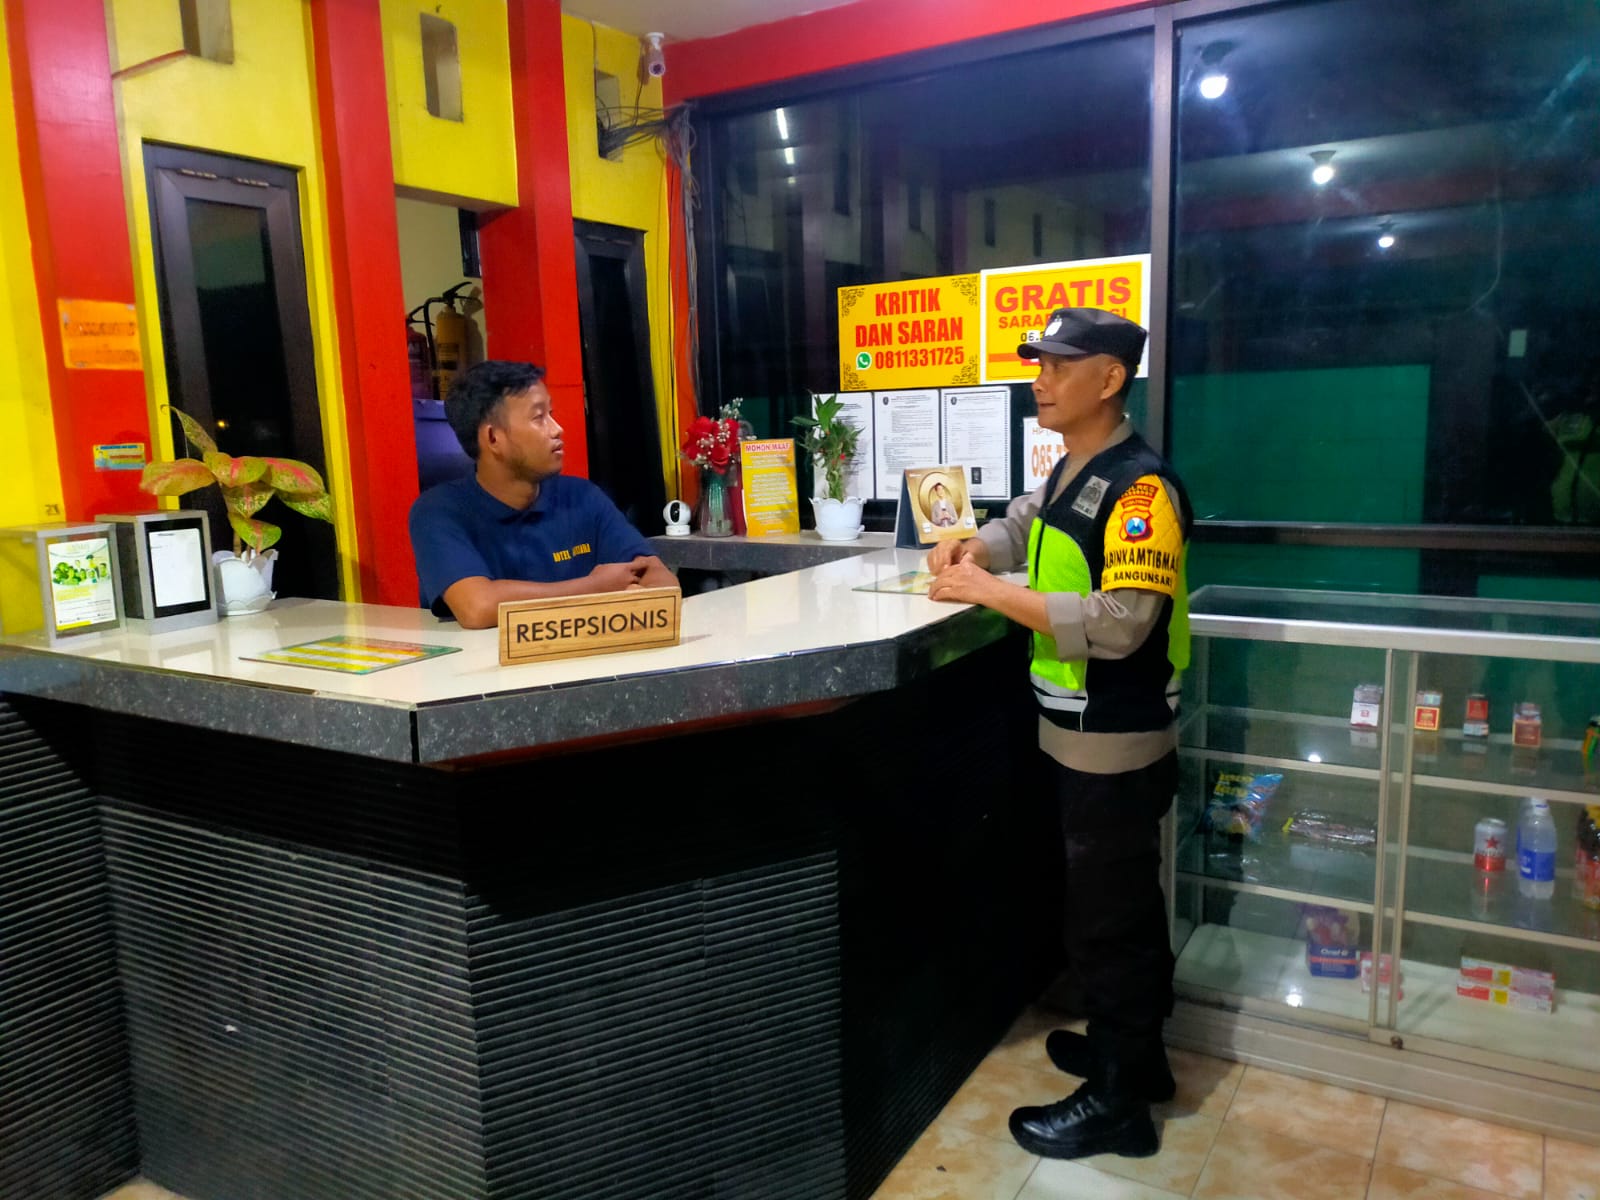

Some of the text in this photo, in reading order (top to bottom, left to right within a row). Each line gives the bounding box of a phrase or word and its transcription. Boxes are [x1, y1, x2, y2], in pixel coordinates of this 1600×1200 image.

[875, 288, 941, 316] KRITIK
[994, 277, 1132, 313] GRATIS
[855, 317, 963, 348] DAN SARAN
[875, 346, 965, 369] 0811331725
[745, 444, 770, 452] MOHON
[516, 609, 668, 643] RESEPSIONIS
